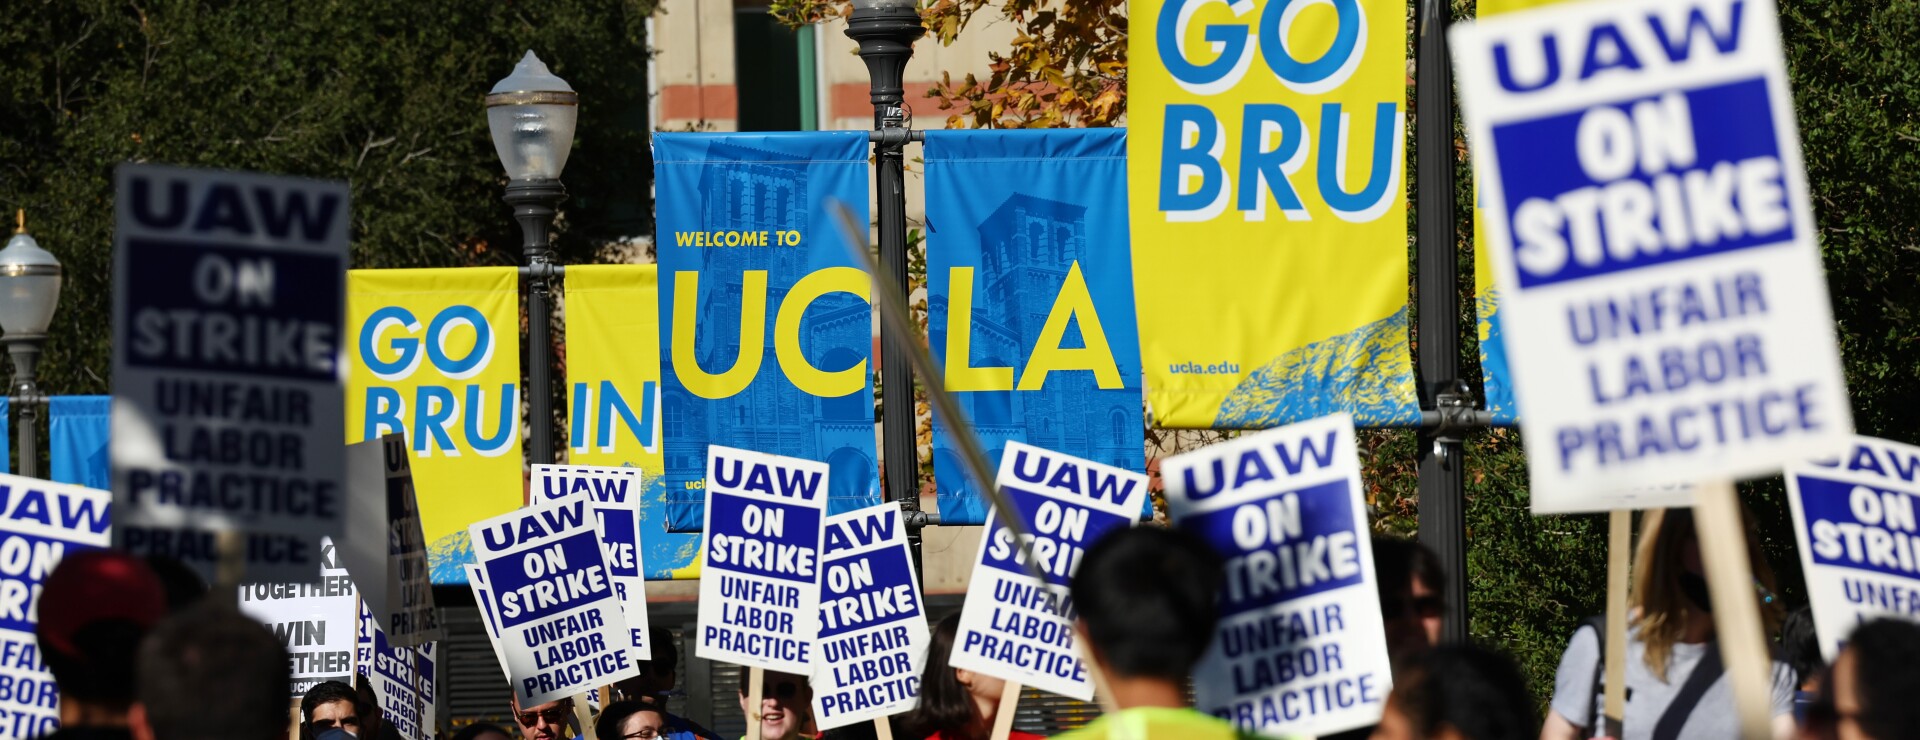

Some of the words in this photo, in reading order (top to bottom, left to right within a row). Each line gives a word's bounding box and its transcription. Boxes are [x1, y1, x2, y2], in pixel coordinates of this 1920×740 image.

[1156, 0, 1368, 95] GO
[1491, 0, 1744, 94] UAW
[1575, 89, 1696, 183] ON
[1158, 102, 1406, 223] BRU
[129, 176, 341, 243] UAW
[1512, 156, 1790, 277] STRIKE
[675, 231, 768, 247] WELCOME
[775, 230, 801, 246] TO
[193, 254, 276, 304] ON
[1566, 270, 1768, 347] UNFAIR
[134, 307, 336, 371] STRIKE
[359, 304, 495, 381] GO
[1169, 361, 1240, 375] ucla.edu
[1587, 332, 1767, 406] LABOR
[155, 377, 312, 427] UNFAIR
[364, 383, 521, 457] BRU
[570, 380, 661, 454] IN
[165, 424, 304, 471] LABOR
[1553, 382, 1823, 474] PRACTICE
[714, 457, 822, 500] UAW
[1013, 450, 1137, 506] UAW
[1184, 430, 1338, 502] UAW
[1808, 444, 1920, 483] AW
[128, 469, 338, 519] PRACTICE
[543, 475, 628, 503] UAW
[1849, 485, 1917, 532] ON
[482, 500, 584, 551] UAW
[742, 504, 784, 538] ON
[823, 510, 895, 555] AW
[1034, 500, 1090, 542] ON
[1233, 492, 1302, 550] ON
[0, 535, 64, 580] ON
[122, 527, 308, 565] PRACICE
[523, 543, 568, 579] ON
[710, 533, 815, 577] STRIKE
[989, 527, 1084, 578] STRI
[1225, 531, 1361, 602] TRIKE
[1811, 518, 1920, 574] STRI
[243, 576, 353, 601] TOGETHER
[501, 565, 607, 618] STRIKE
[720, 575, 800, 609] UNFAIR
[827, 558, 873, 593] ON
[523, 608, 604, 648] UNFAIR
[722, 603, 793, 634] LABOR
[990, 607, 1074, 649] LABOR
[1221, 603, 1344, 658] UNFAIR
[533, 632, 606, 670] LABOR
[705, 625, 810, 663] PRACTICE
[823, 626, 910, 664] UNFAIR
[964, 630, 1088, 683] PRACTICE
[0, 675, 59, 709] BOR
[523, 649, 630, 698] PRACTICE
[833, 652, 912, 688] LABOR
[1232, 644, 1344, 695] LABOR
[385, 696, 418, 724] LABO
[821, 675, 922, 718] PRACTIC
